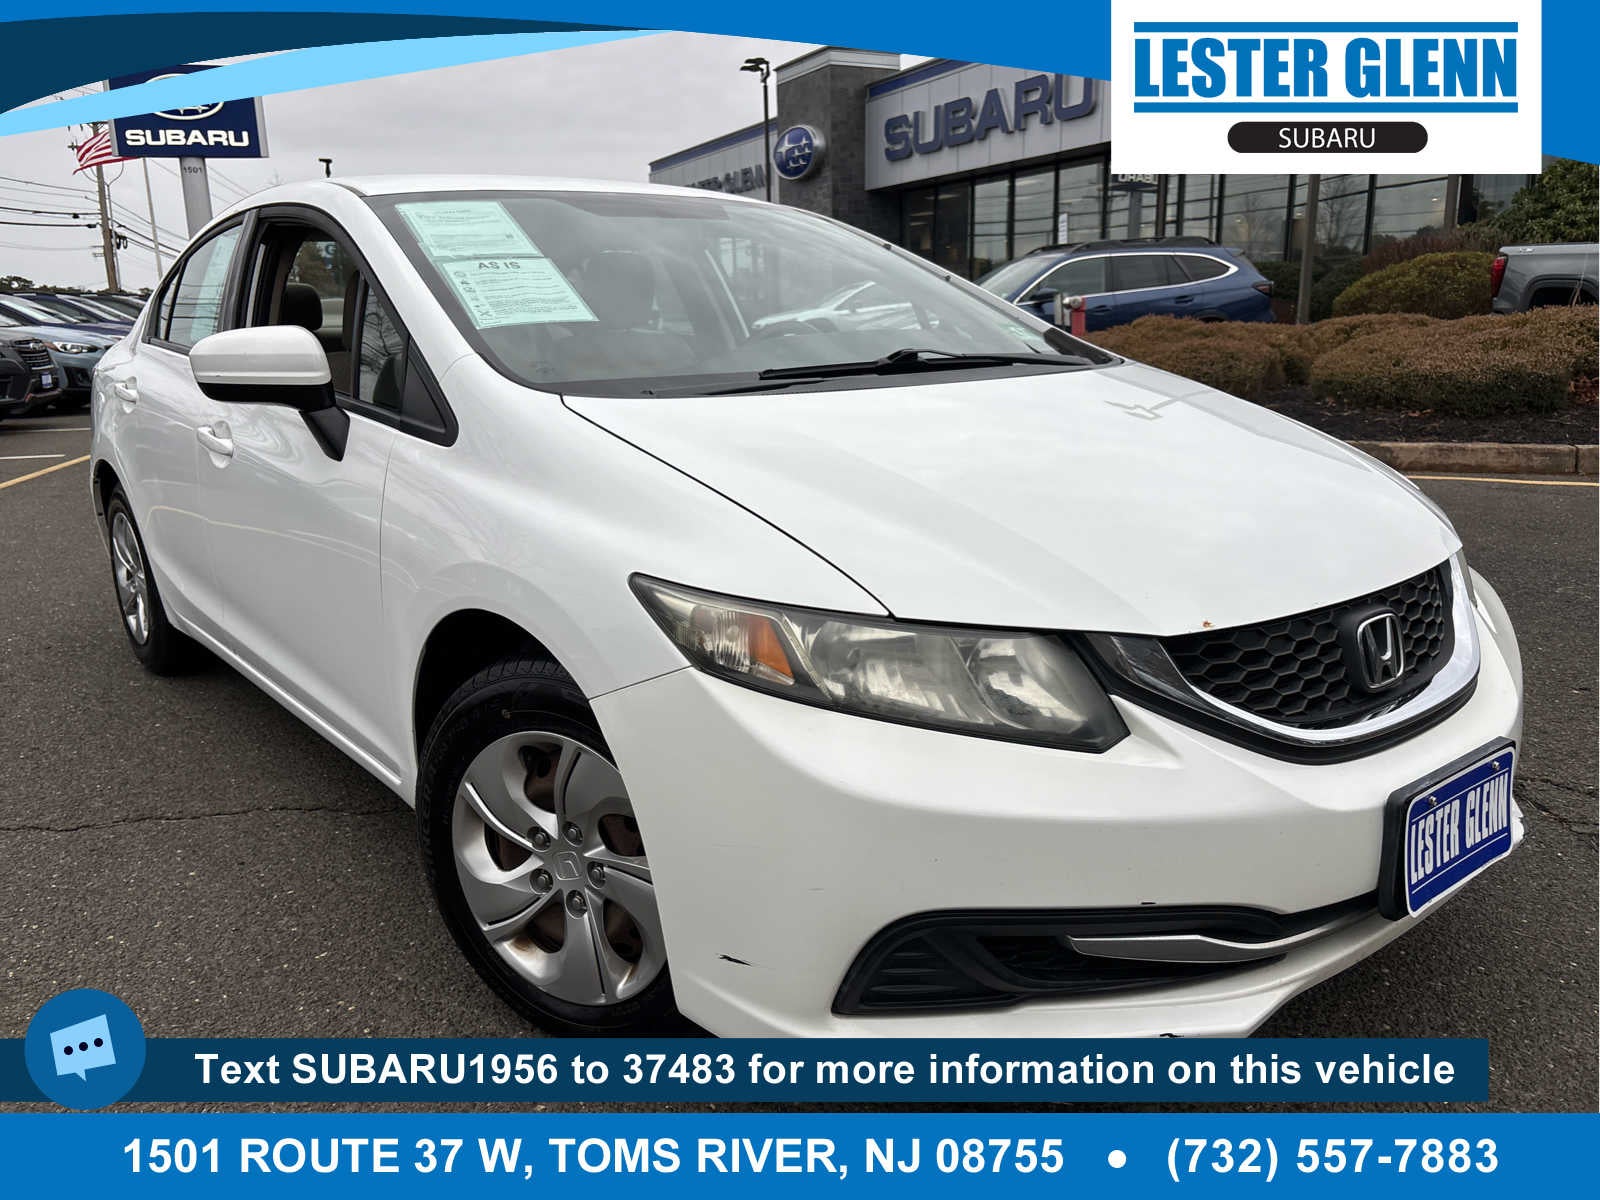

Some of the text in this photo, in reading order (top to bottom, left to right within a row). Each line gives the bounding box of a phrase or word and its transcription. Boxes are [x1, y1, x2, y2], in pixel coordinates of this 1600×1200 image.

[885, 74, 1096, 162] SUBARU
[125, 129, 250, 147] SUBARU
[183, 166, 203, 174] 1501
[478, 261, 521, 270] AS IS
[1411, 772, 1509, 885] LESTER GLENN
